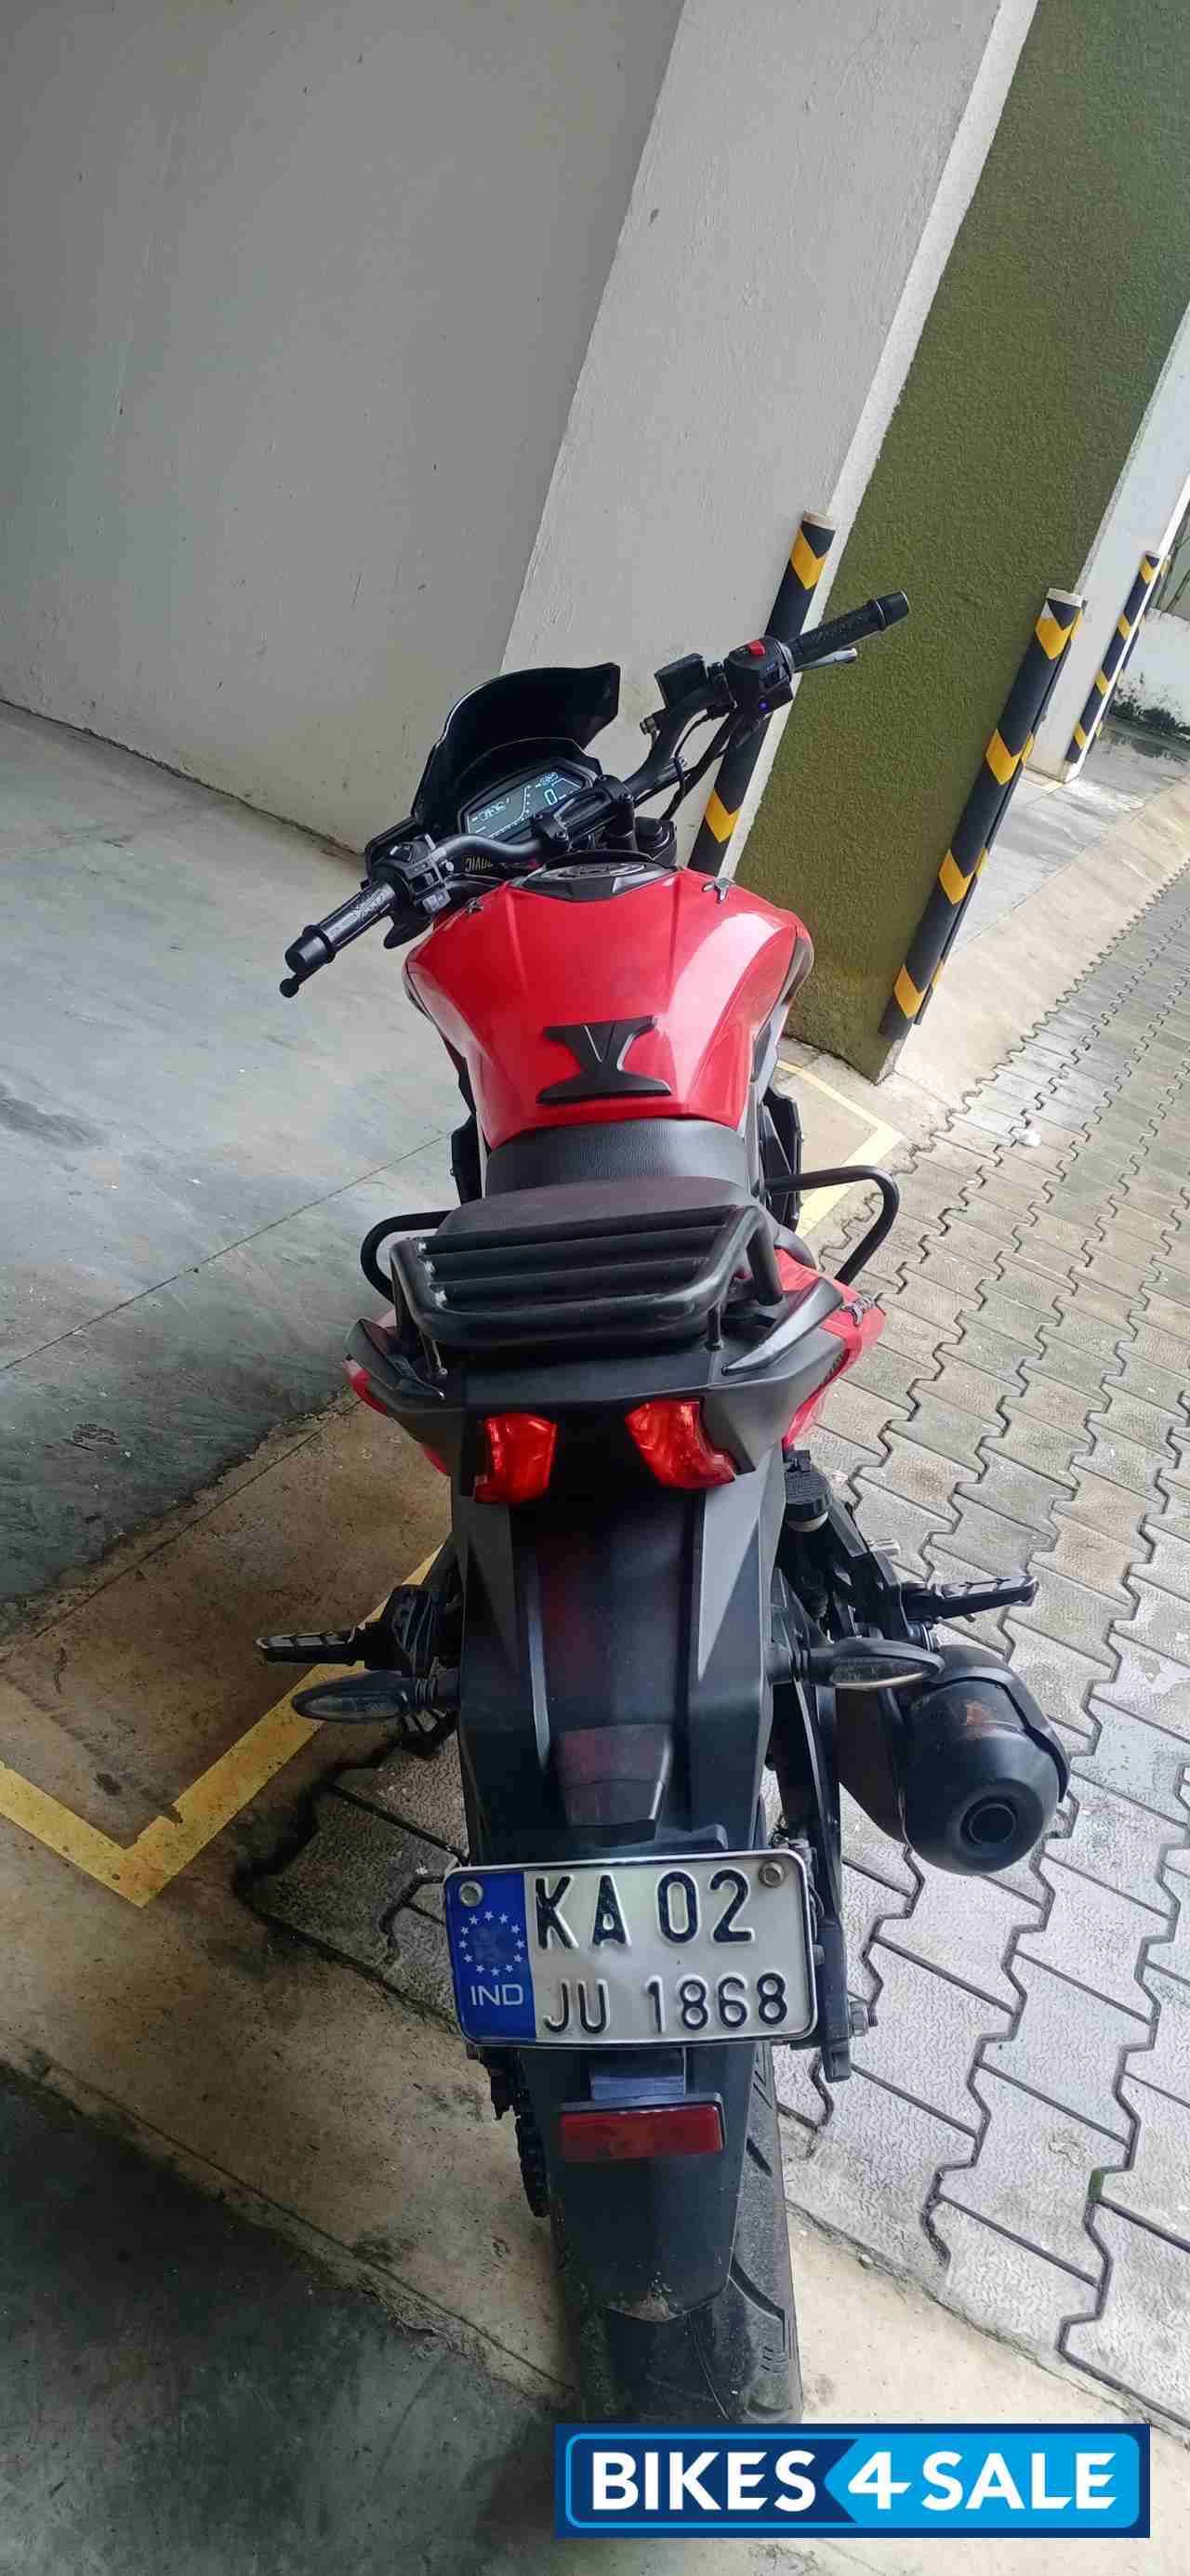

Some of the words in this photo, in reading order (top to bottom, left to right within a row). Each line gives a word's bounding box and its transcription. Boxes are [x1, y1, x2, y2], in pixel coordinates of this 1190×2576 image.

[534, 1873, 630, 1950] KA
[656, 1869, 753, 1944] 02
[470, 1984, 523, 2006] IND
[542, 1981, 607, 2035] JU
[645, 1972, 788, 2035] 1868
